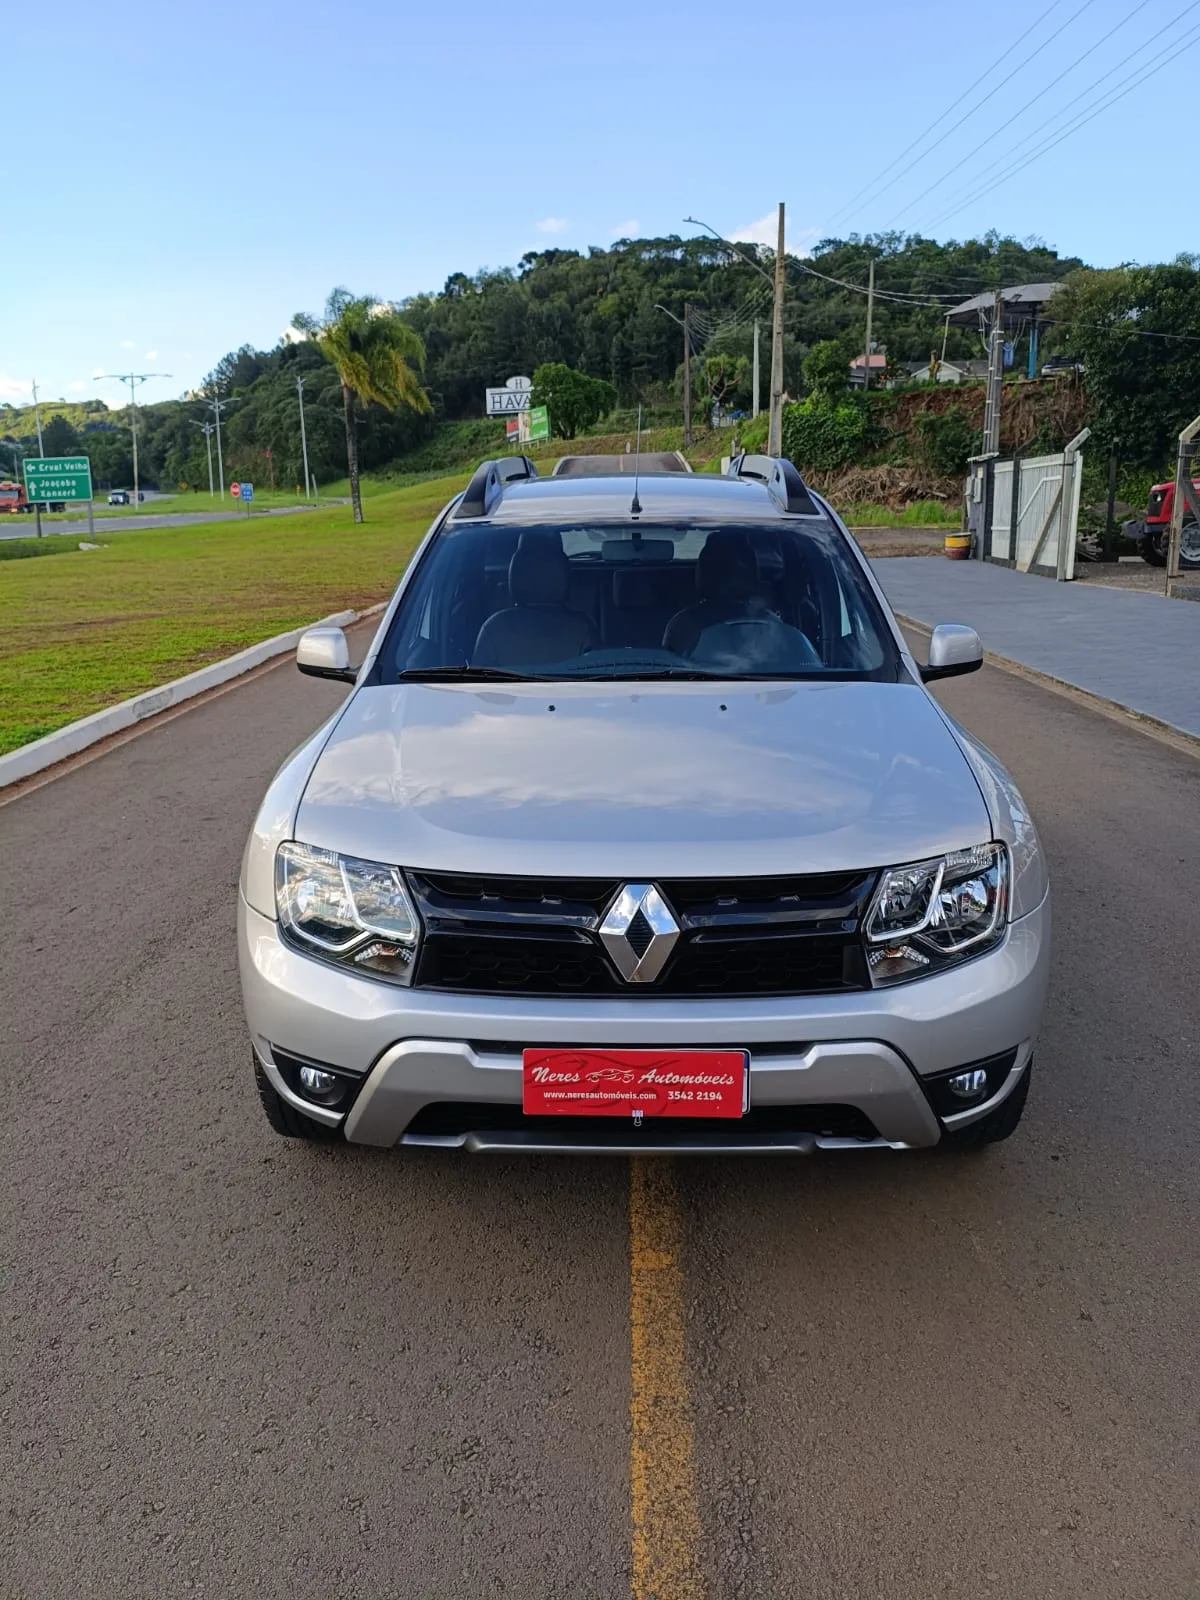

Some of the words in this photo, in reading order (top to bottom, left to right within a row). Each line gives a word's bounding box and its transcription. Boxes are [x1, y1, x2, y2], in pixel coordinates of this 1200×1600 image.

[492, 394, 531, 409] HAVA
[38, 463, 62, 472] Erval
[64, 462, 88, 470] Velho
[531, 1067, 581, 1083] Neres
[638, 1068, 735, 1085] Automóveis
[543, 1091, 657, 1100] www.neresautomóveis.com
[668, 1091, 694, 1100] 3542
[696, 1091, 723, 1101] 2194
